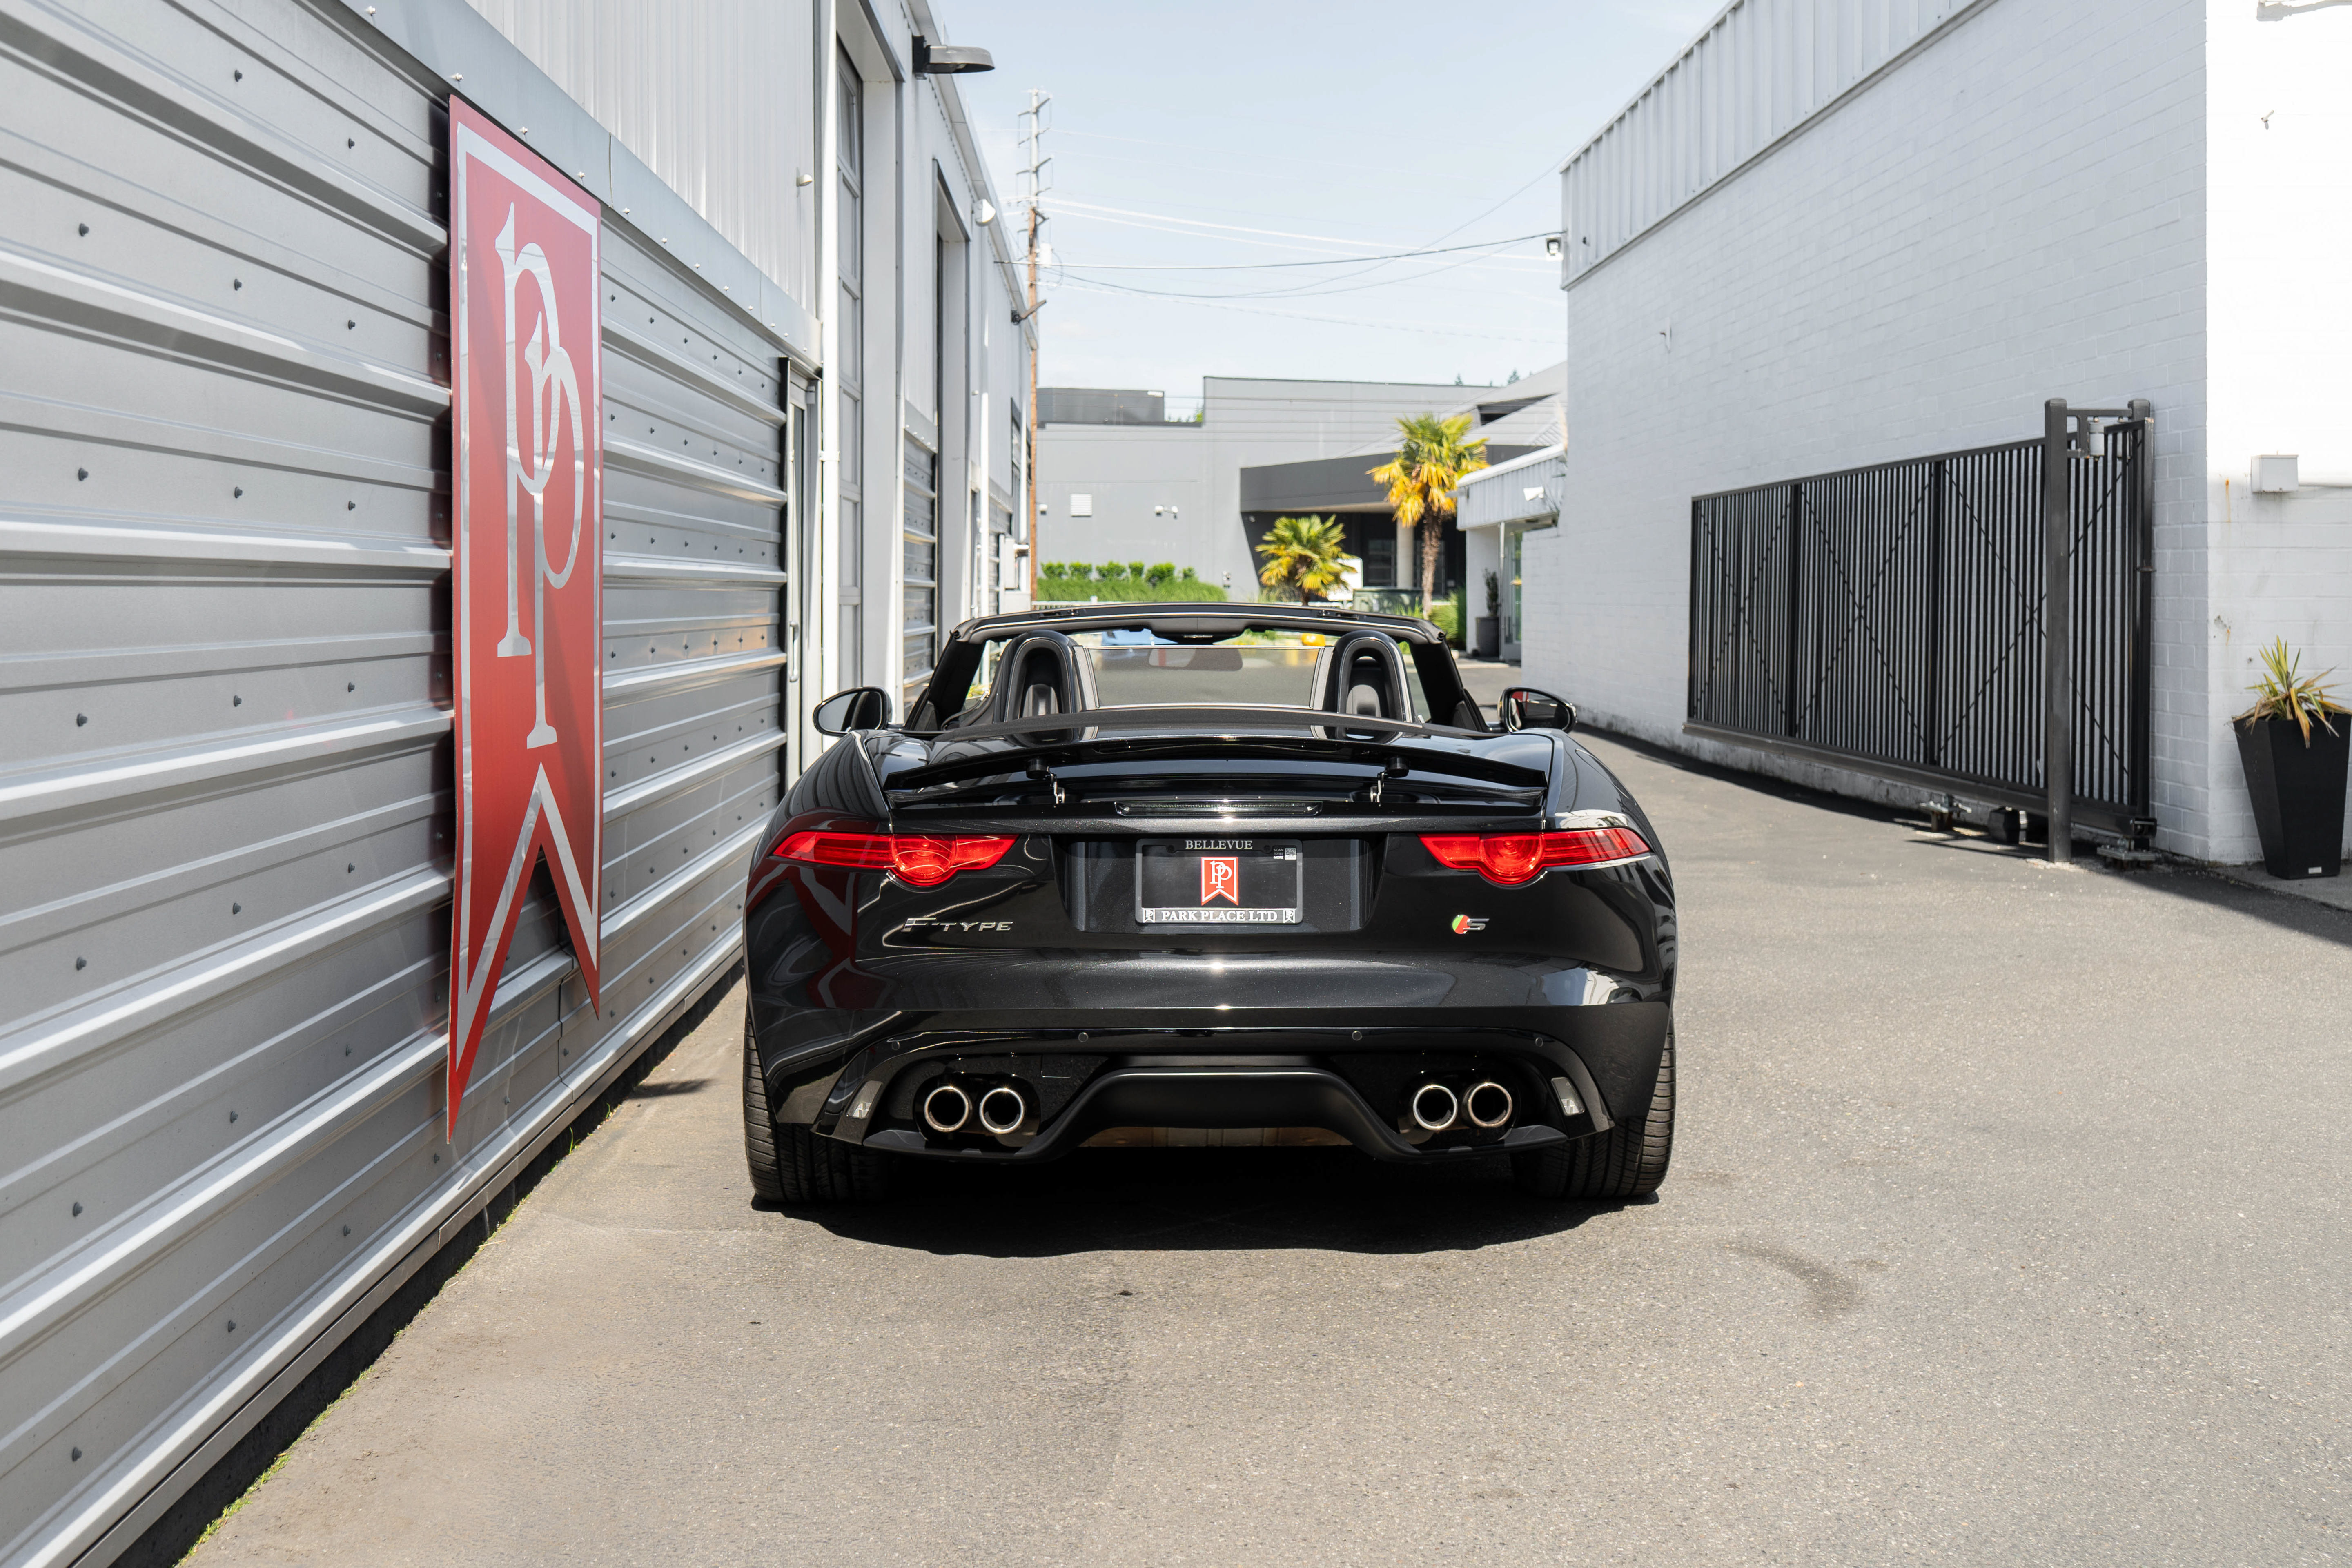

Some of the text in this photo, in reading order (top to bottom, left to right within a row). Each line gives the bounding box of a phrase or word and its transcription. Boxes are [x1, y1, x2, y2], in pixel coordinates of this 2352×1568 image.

[1185, 840, 1253, 849] BELLEVUE
[1161, 911, 1278, 921] PARK PLACE LTD
[900, 918, 1013, 932] F-TYPE
[1463, 918, 1490, 931] S
